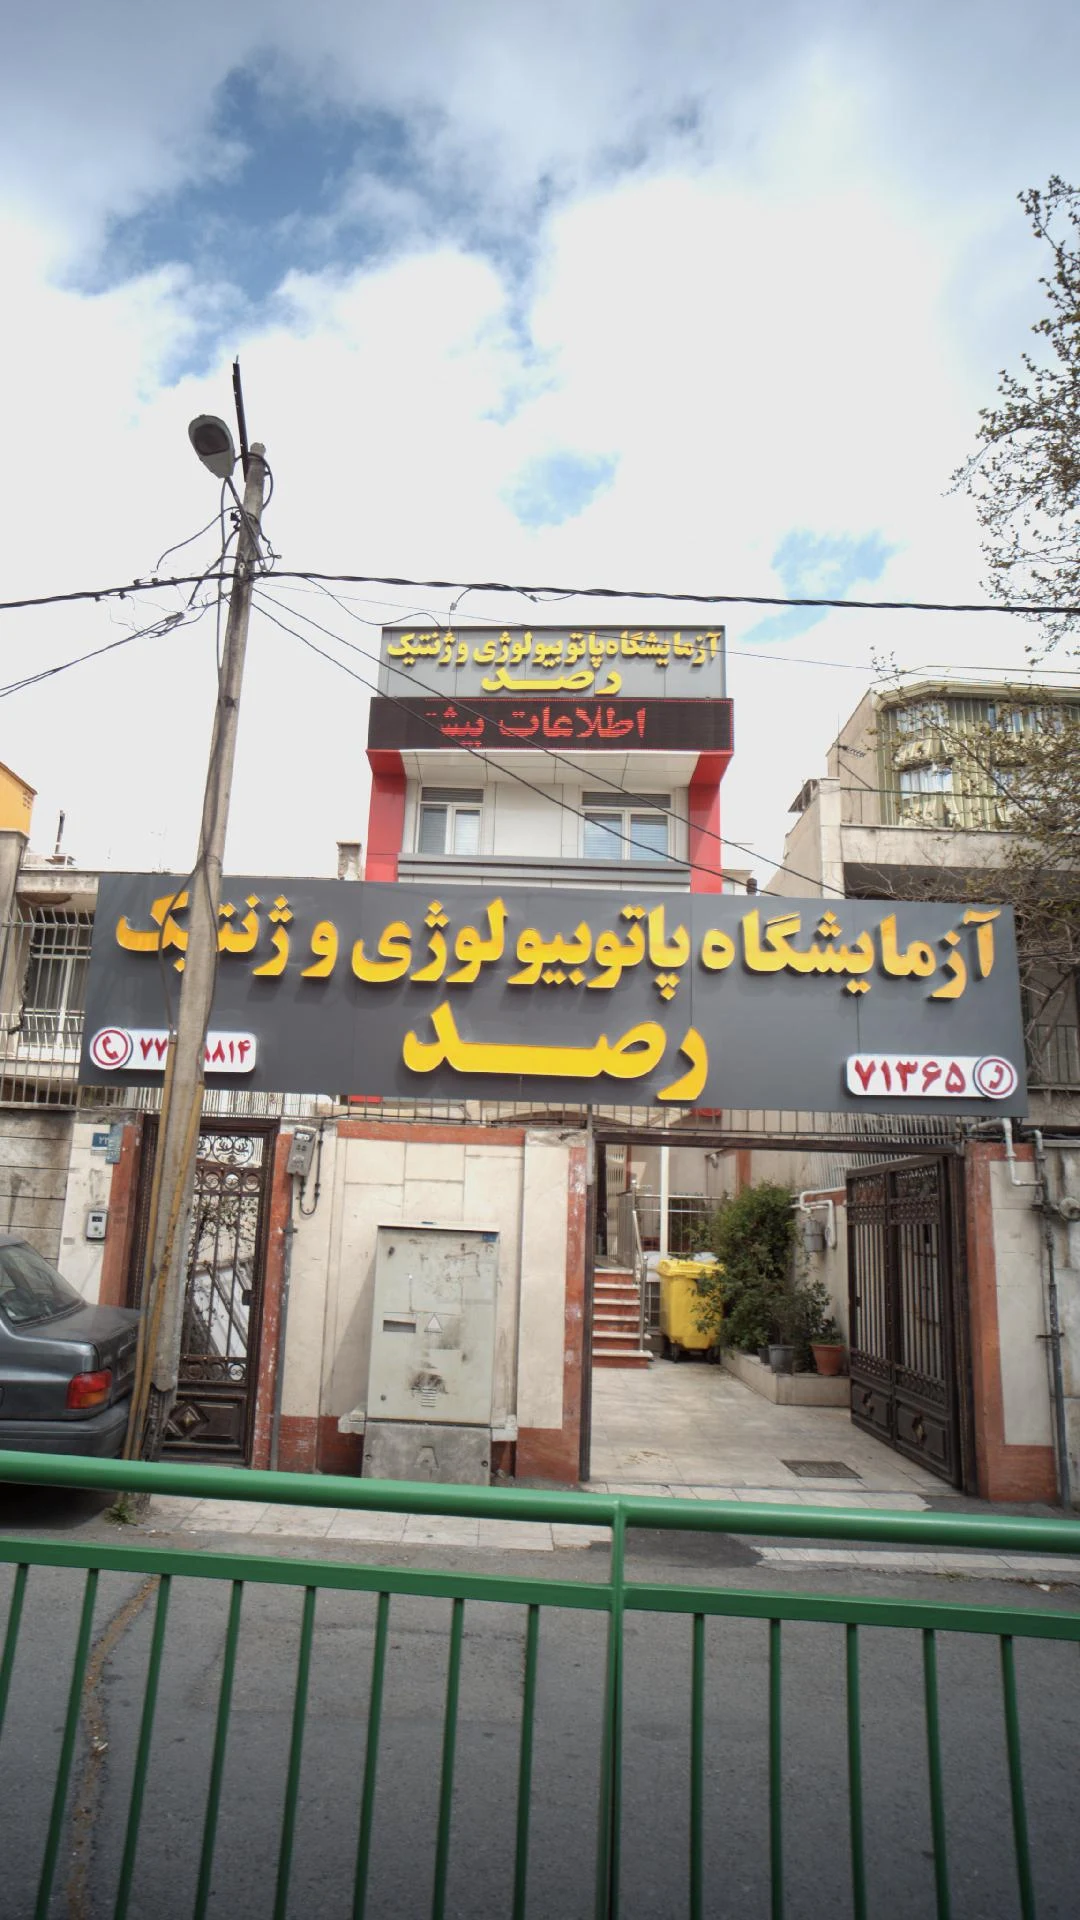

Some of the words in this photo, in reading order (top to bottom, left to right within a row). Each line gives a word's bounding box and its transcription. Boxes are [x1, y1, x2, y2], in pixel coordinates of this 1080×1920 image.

[386, 630, 456, 665] ژنتیک
[455, 640, 469, 664] و
[472, 630, 605, 668] پاتوبیولوژی
[606, 630, 722, 666] آزمایشگاه
[481, 666, 622, 695] رصد
[499, 705, 647, 738] اطلاعات
[301, 920, 339, 978] و
[351, 896, 691, 1001] پاتوبیولوژی
[701, 906, 1001, 999] آزمایشگاه
[402, 999, 709, 1101] رصد
[854, 1059, 966, 1094] ۷۱۳۶۵
